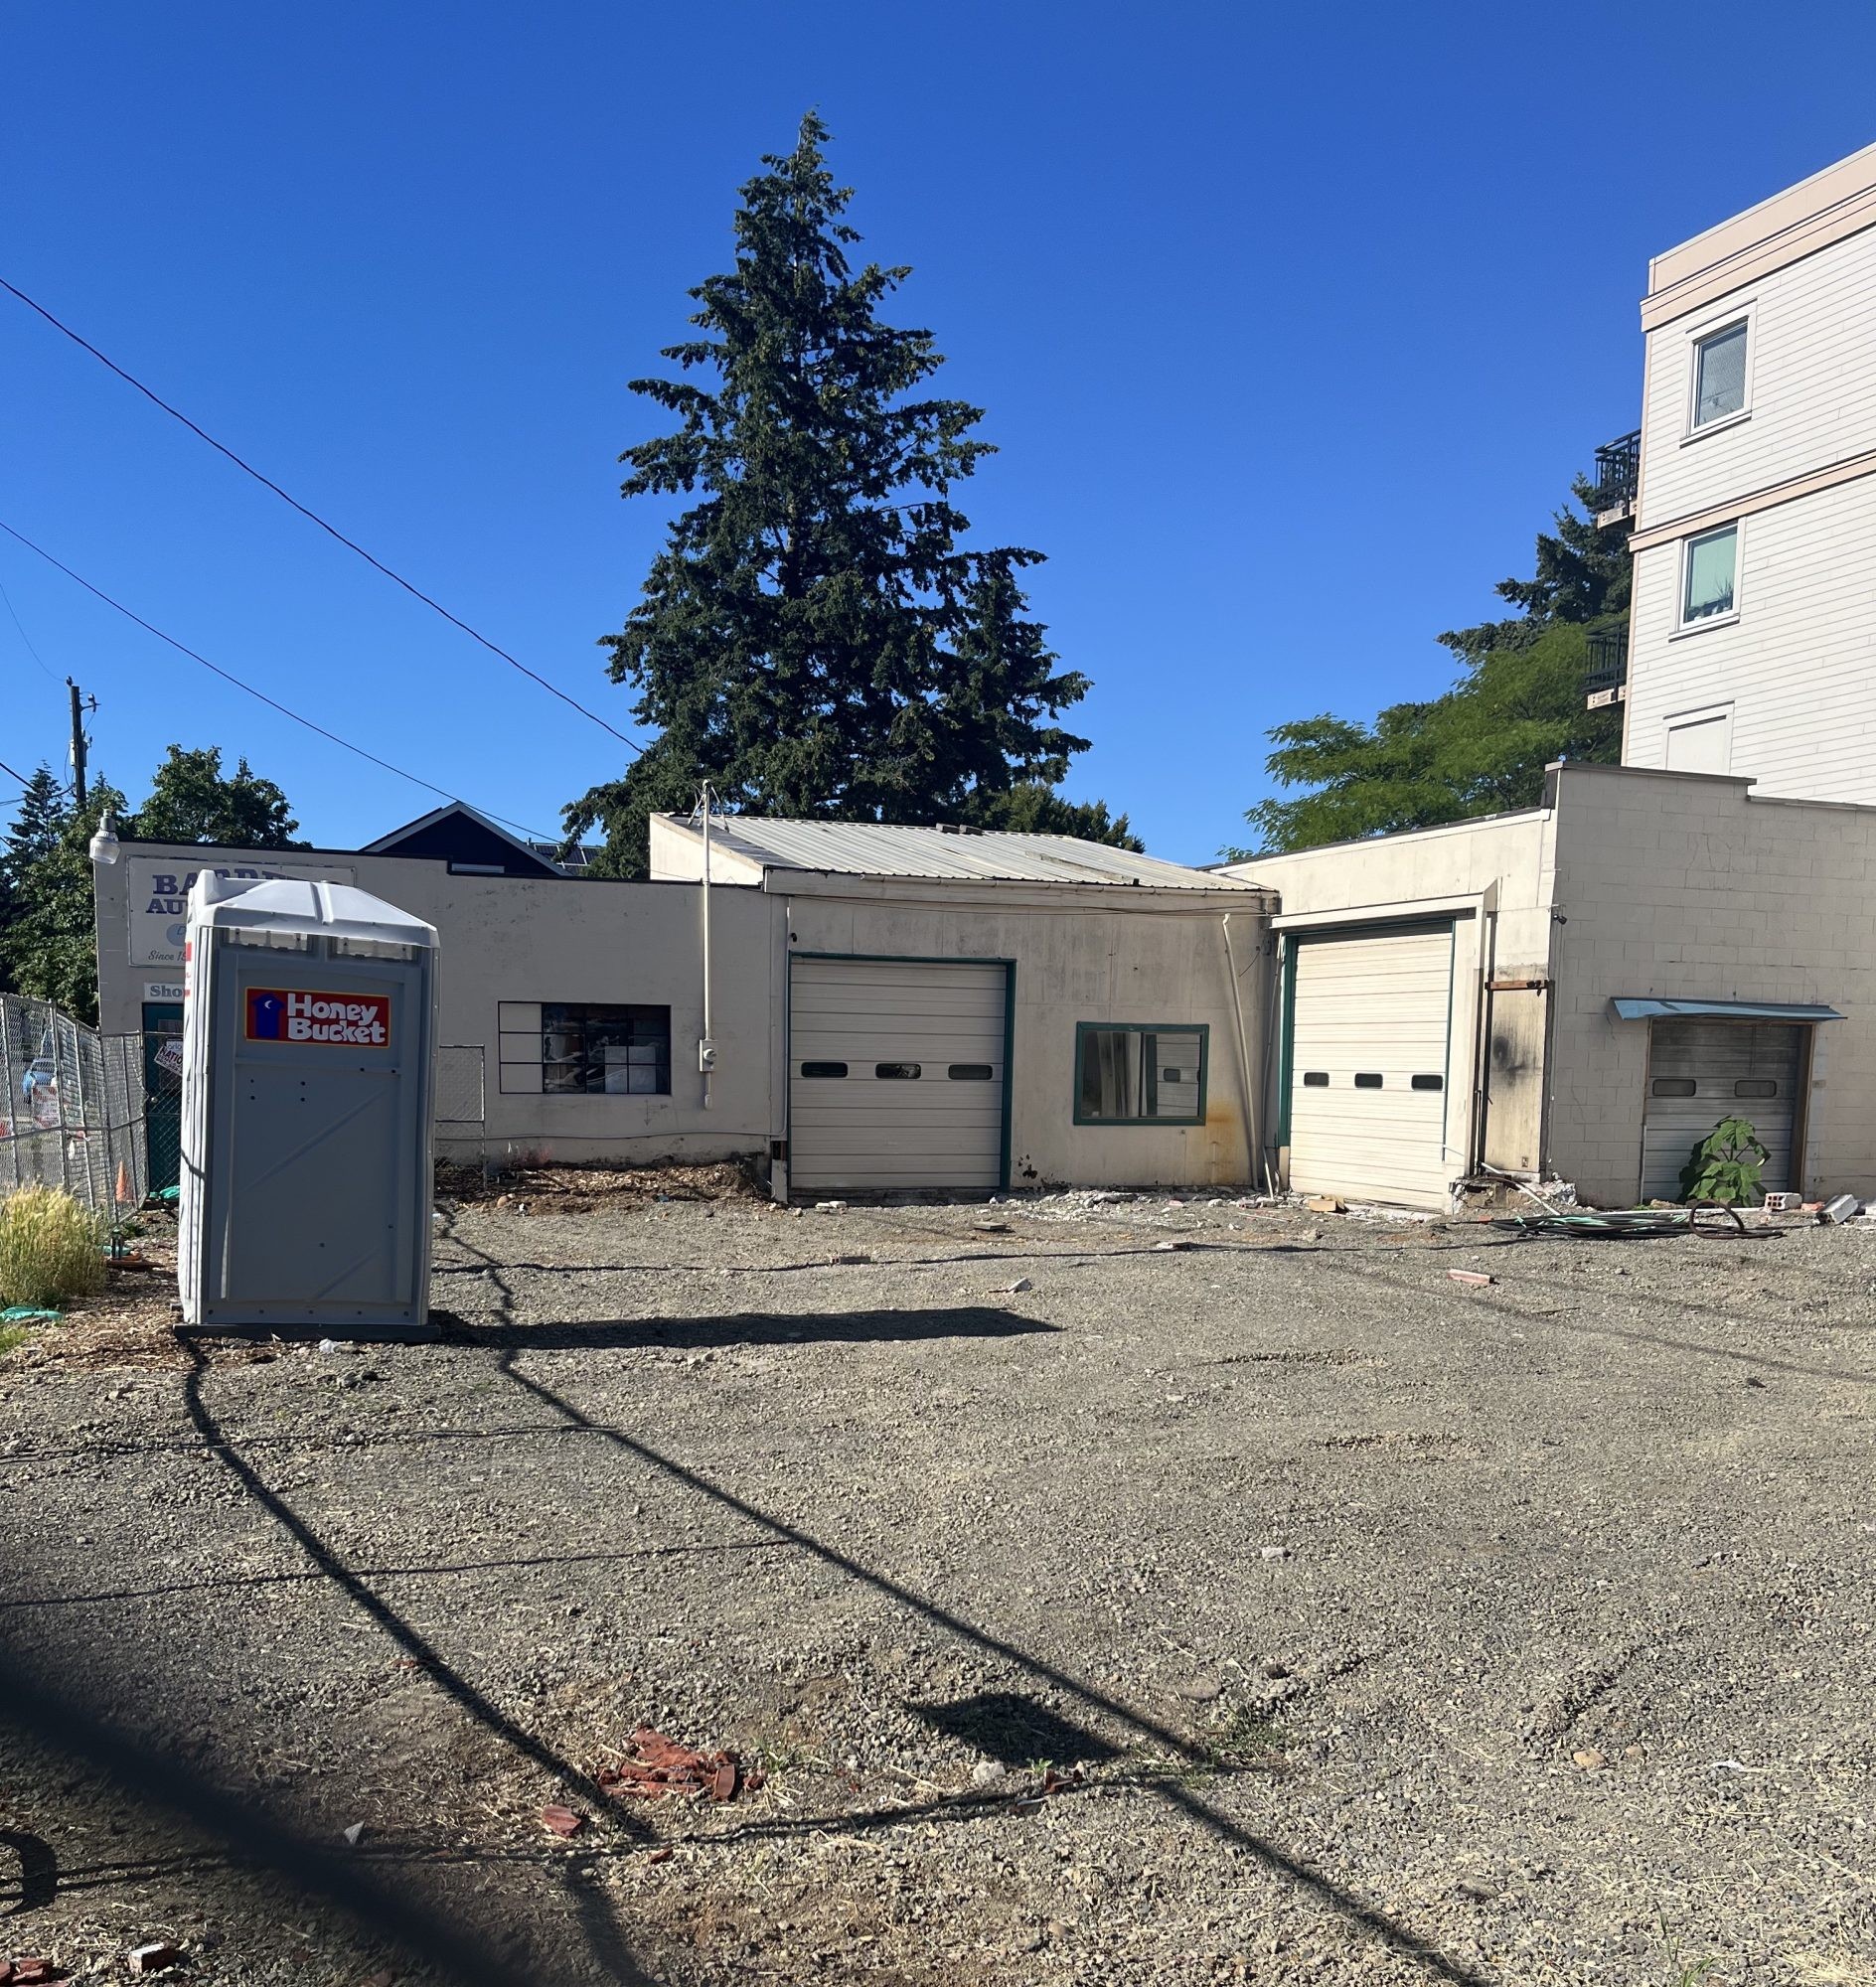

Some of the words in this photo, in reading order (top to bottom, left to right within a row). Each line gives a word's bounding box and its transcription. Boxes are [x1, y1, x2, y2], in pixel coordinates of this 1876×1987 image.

[148, 950, 175, 962] Since
[150, 985, 185, 997] Sho
[287, 993, 378, 1026] Honey
[287, 1017, 386, 1043] Bucket
